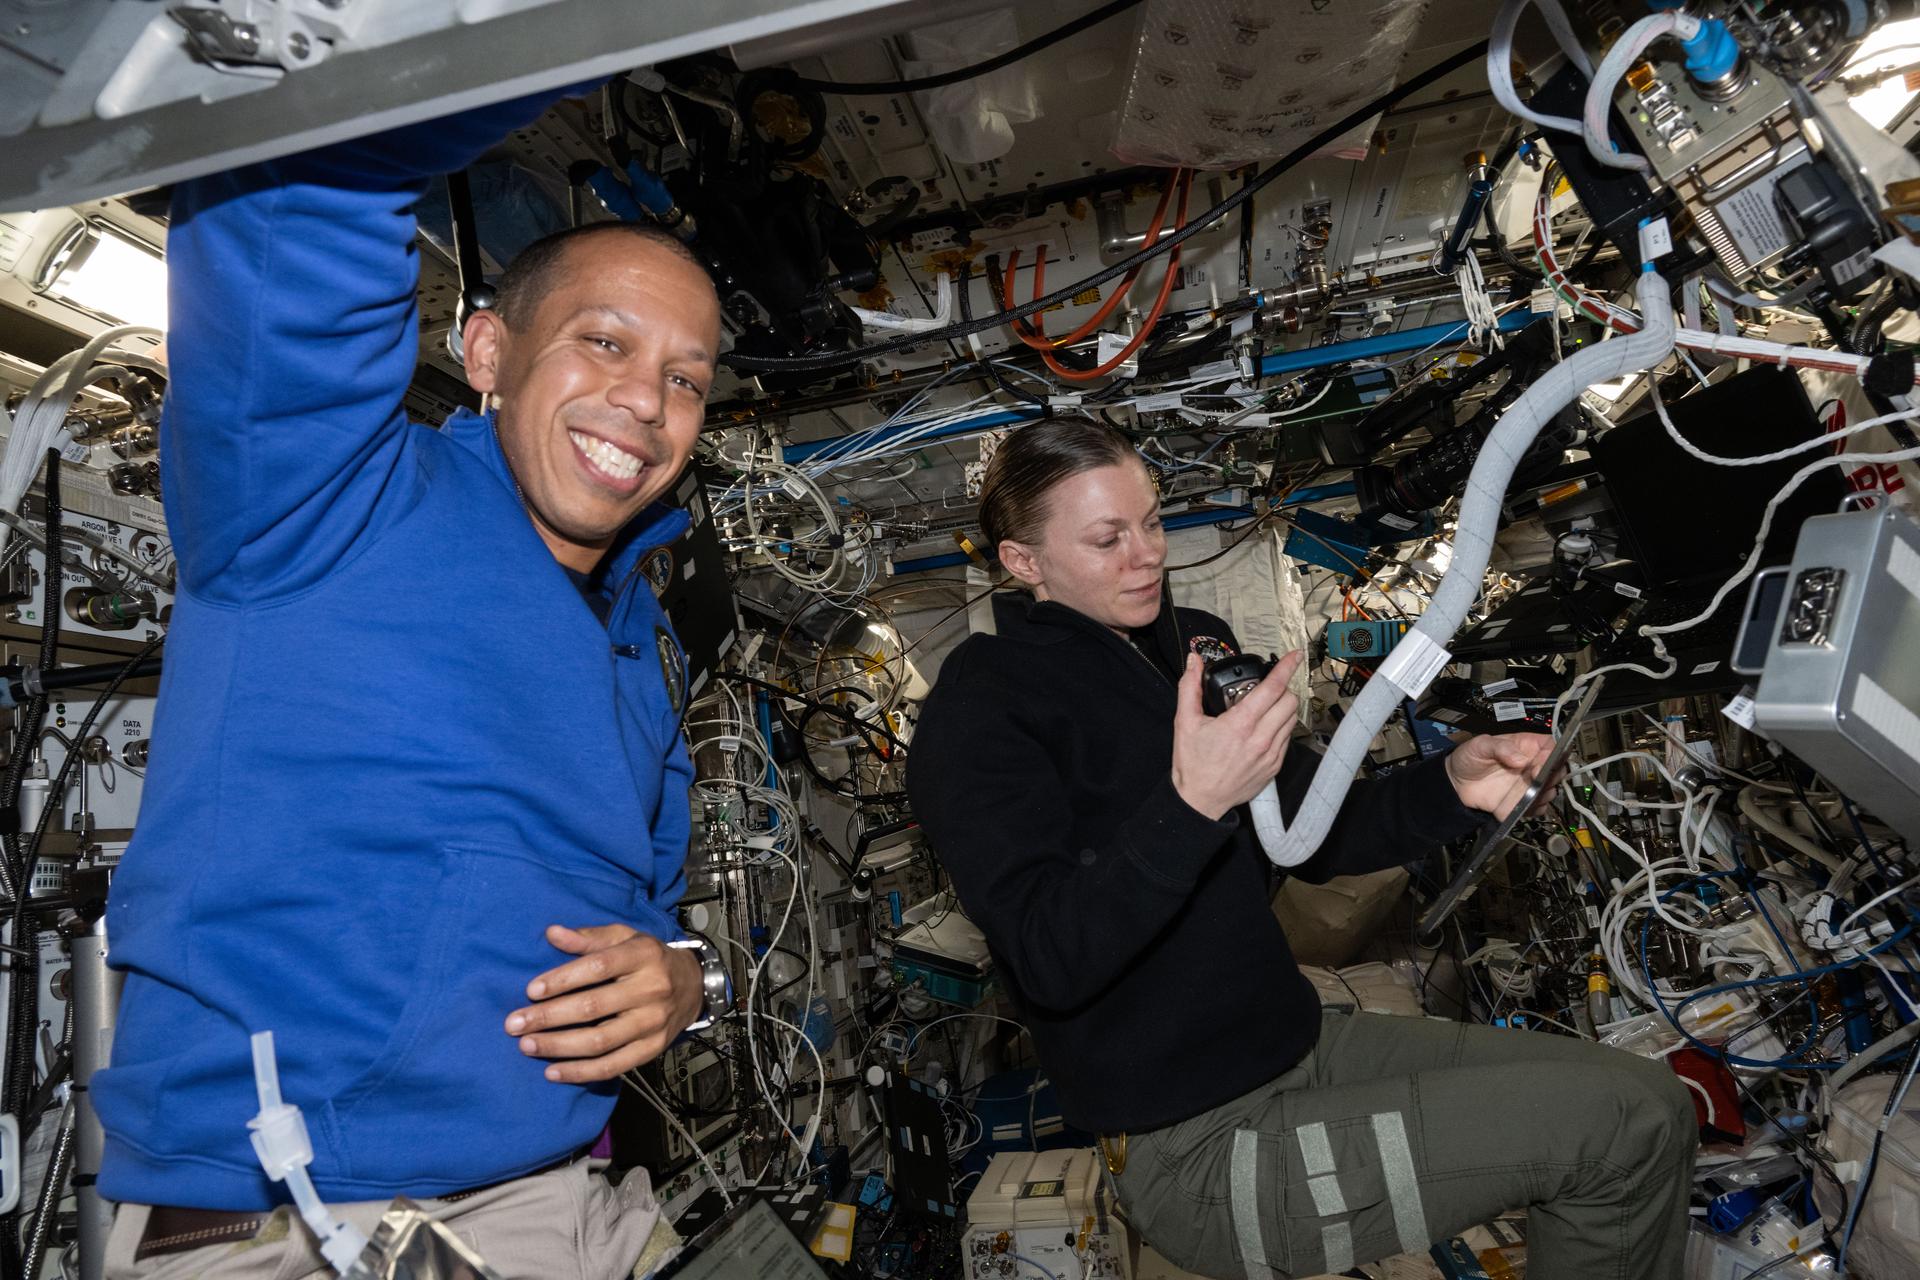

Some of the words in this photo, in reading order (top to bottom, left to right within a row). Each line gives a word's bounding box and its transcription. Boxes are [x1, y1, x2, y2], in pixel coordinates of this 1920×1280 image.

[81, 521, 107, 532] ARGON
[71, 574, 85, 584] OUT
[123, 720, 141, 728] DATA
[124, 729, 140, 737] J210
